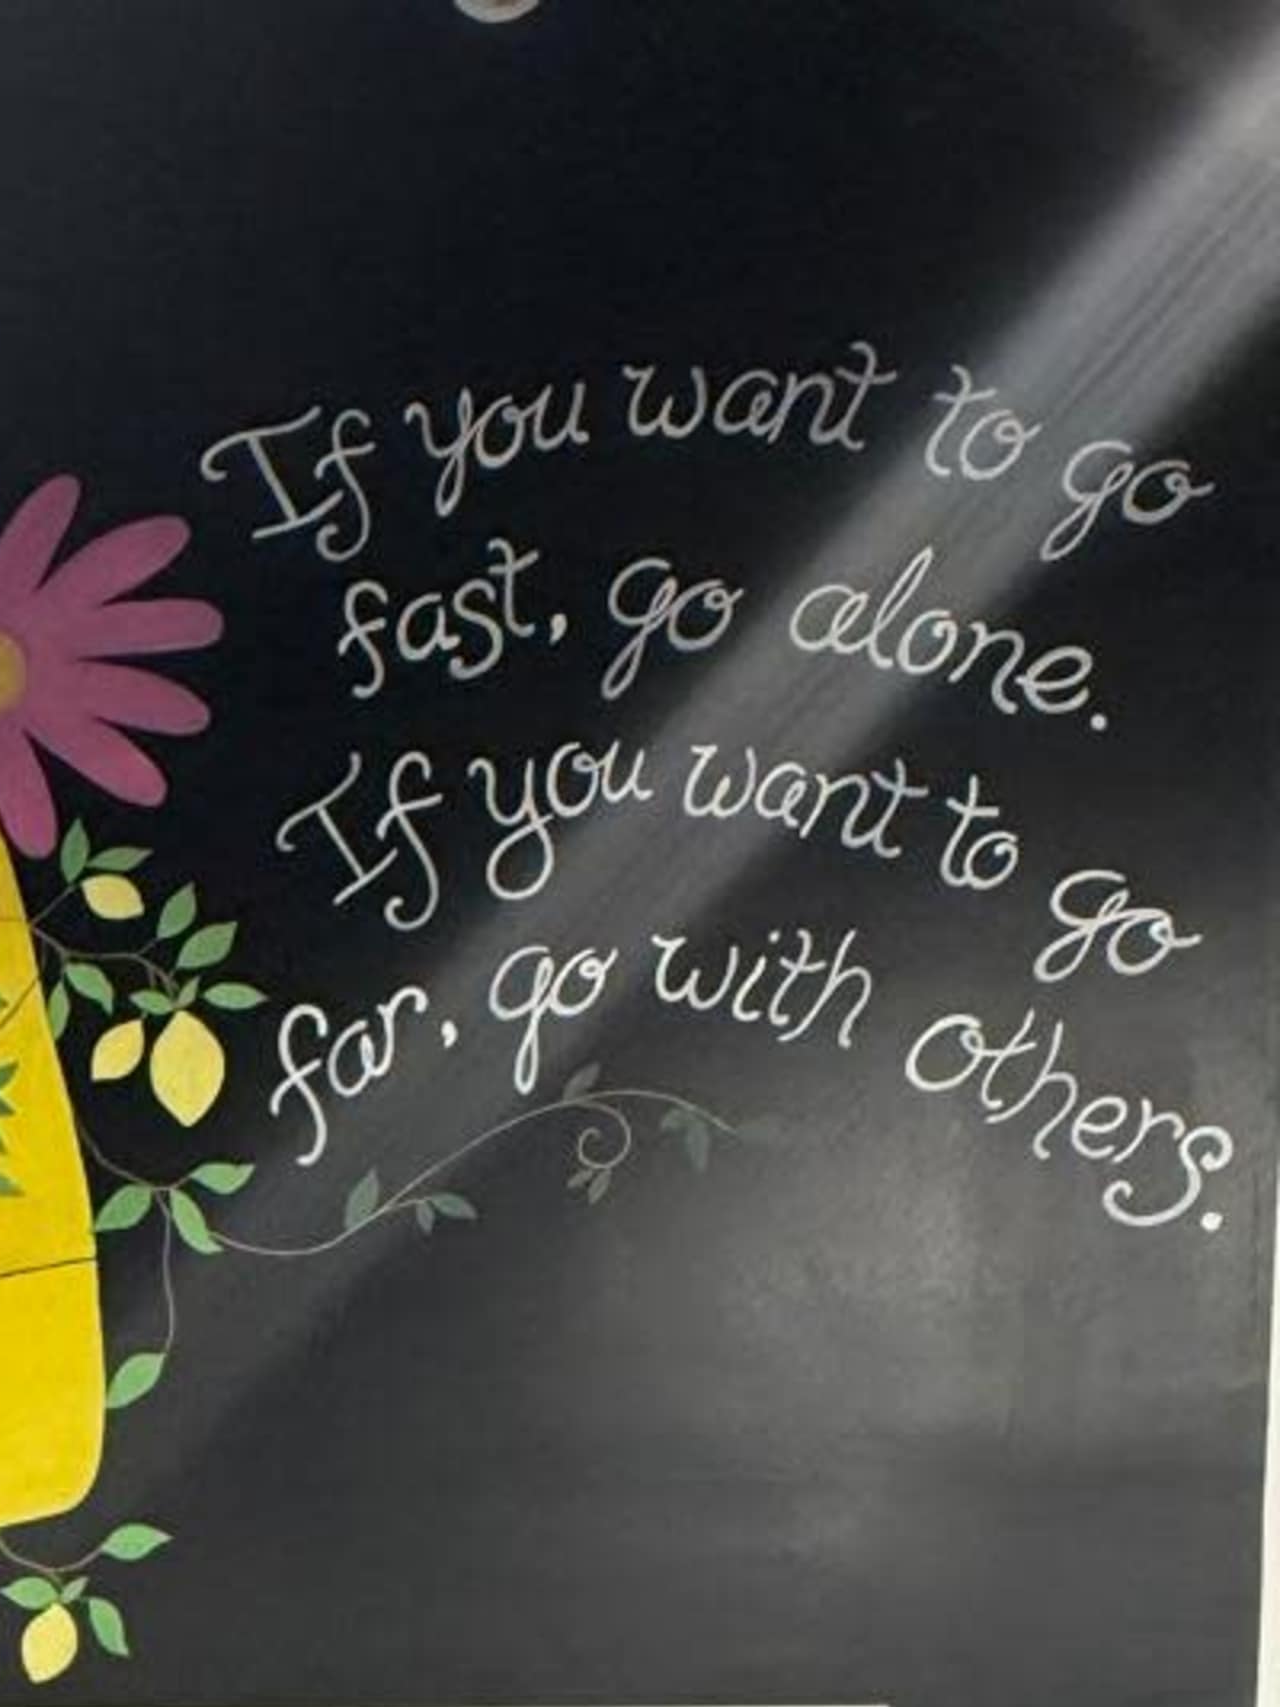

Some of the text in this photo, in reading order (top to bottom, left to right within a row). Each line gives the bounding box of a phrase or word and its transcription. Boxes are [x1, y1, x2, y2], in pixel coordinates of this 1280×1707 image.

[201, 341, 1216, 562] If you want to go
[338, 538, 1108, 731] fast, go alone.
[275, 737, 1204, 983] If you want to go
[271, 928, 1233, 1231] far, go with others.
